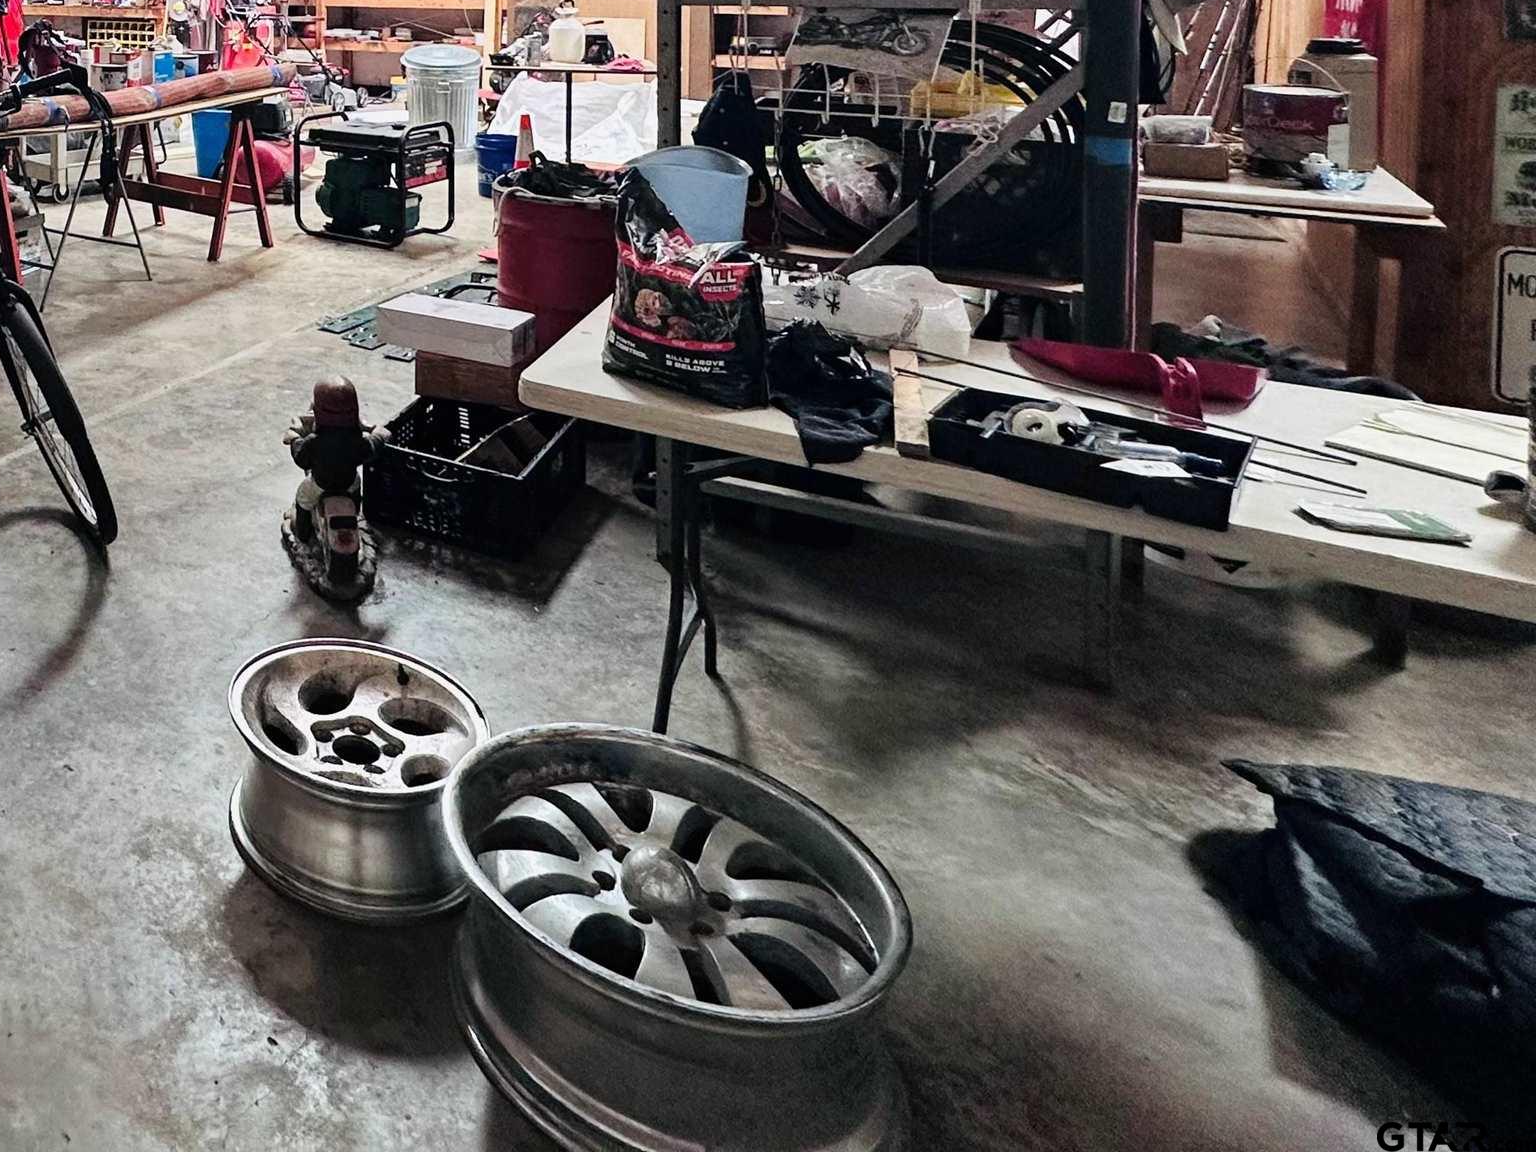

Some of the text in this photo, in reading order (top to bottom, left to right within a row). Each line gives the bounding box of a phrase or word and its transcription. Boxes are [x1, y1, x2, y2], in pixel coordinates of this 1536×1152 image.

[700, 269, 737, 284] ALL
[703, 285, 737, 293] INSECTS
[665, 353, 725, 367] KILLS ABOVE
[674, 361, 711, 374] BELOW
